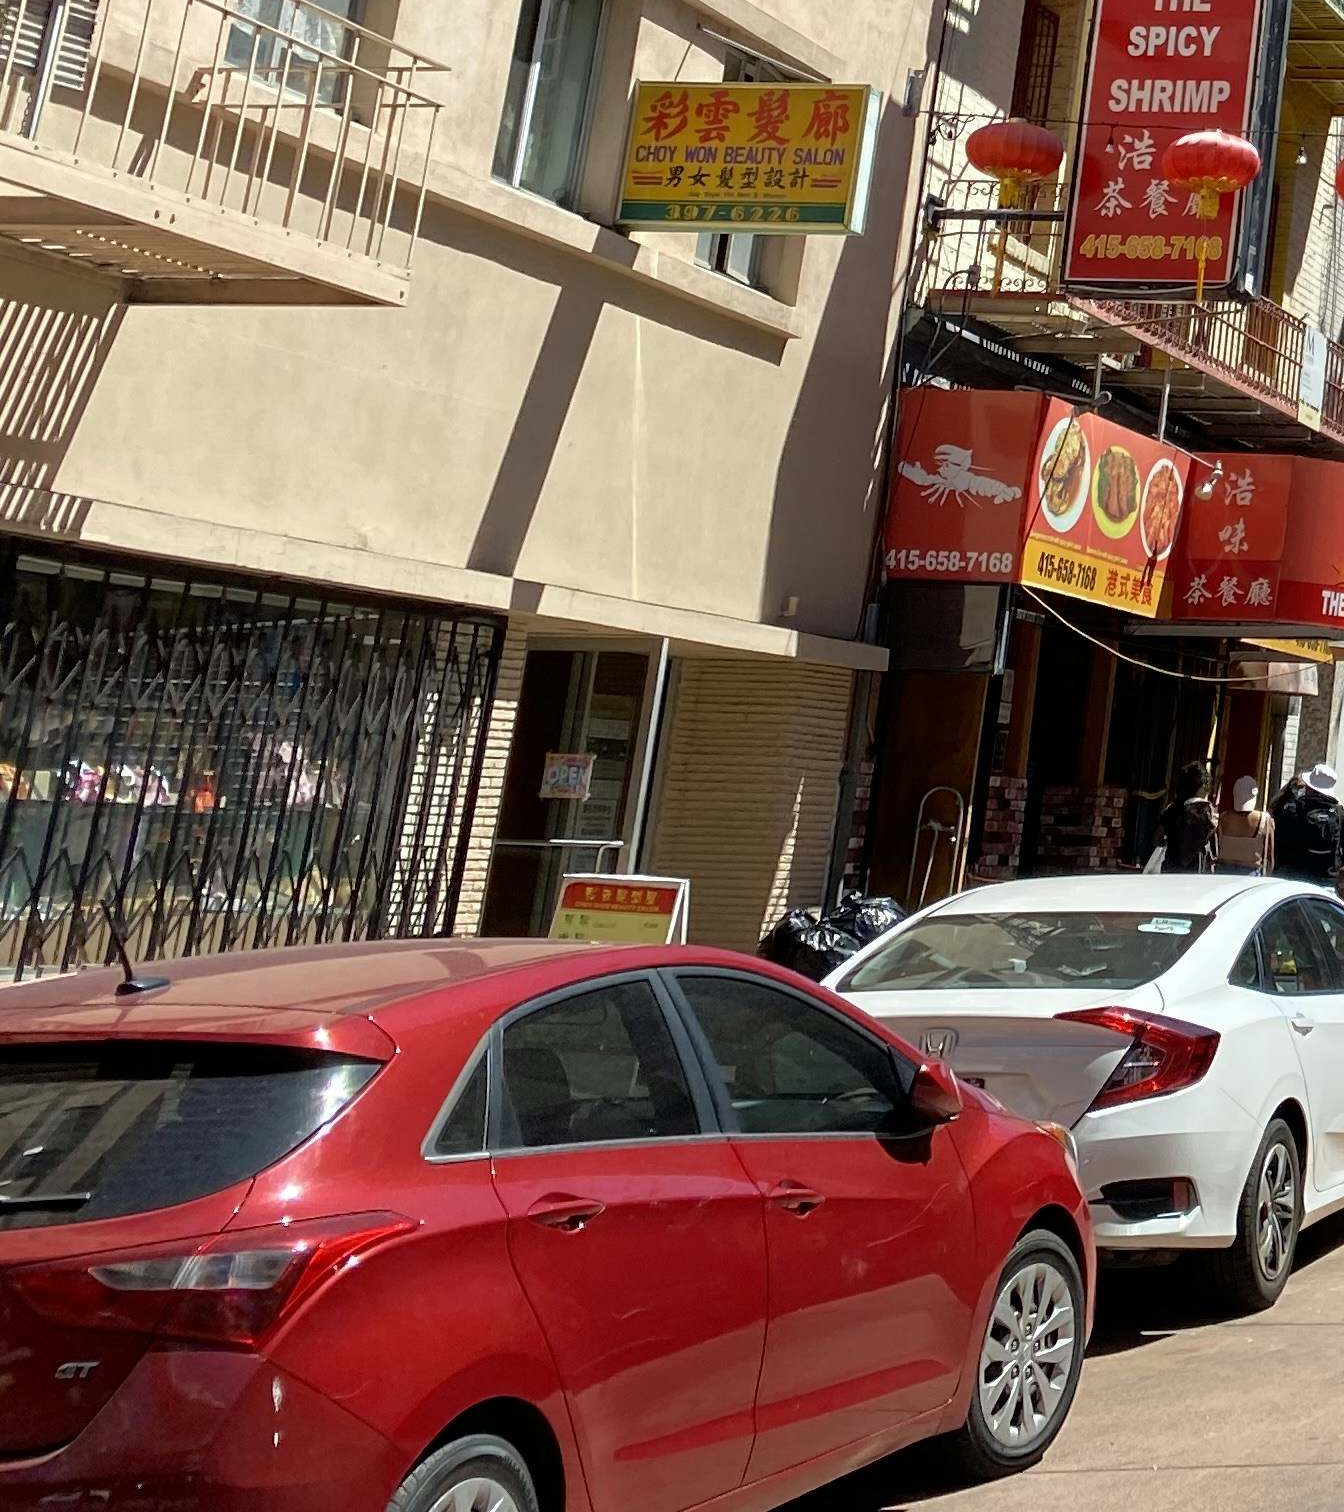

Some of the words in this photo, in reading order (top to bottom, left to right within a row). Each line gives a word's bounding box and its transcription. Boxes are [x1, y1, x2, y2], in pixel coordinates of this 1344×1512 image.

[1127, 26, 1221, 57] SPICY
[1108, 78, 1231, 114] SHRIMP
[640, 88, 850, 147] 彩雲髮廊
[635, 145, 678, 164] CHOY
[684, 145, 718, 165] WON
[724, 146, 787, 166] BEAUTY
[793, 147, 845, 167] SALON
[664, 165, 810, 190] 男女髮型設計
[665, 204, 800, 222] 397-6226
[886, 549, 1013, 573] 415-658-7168
[1037, 552, 1098, 592] 415-658-7168
[1183, 574, 1273, 607] 茶餐廳
[550, 765, 587, 786] OPEN
